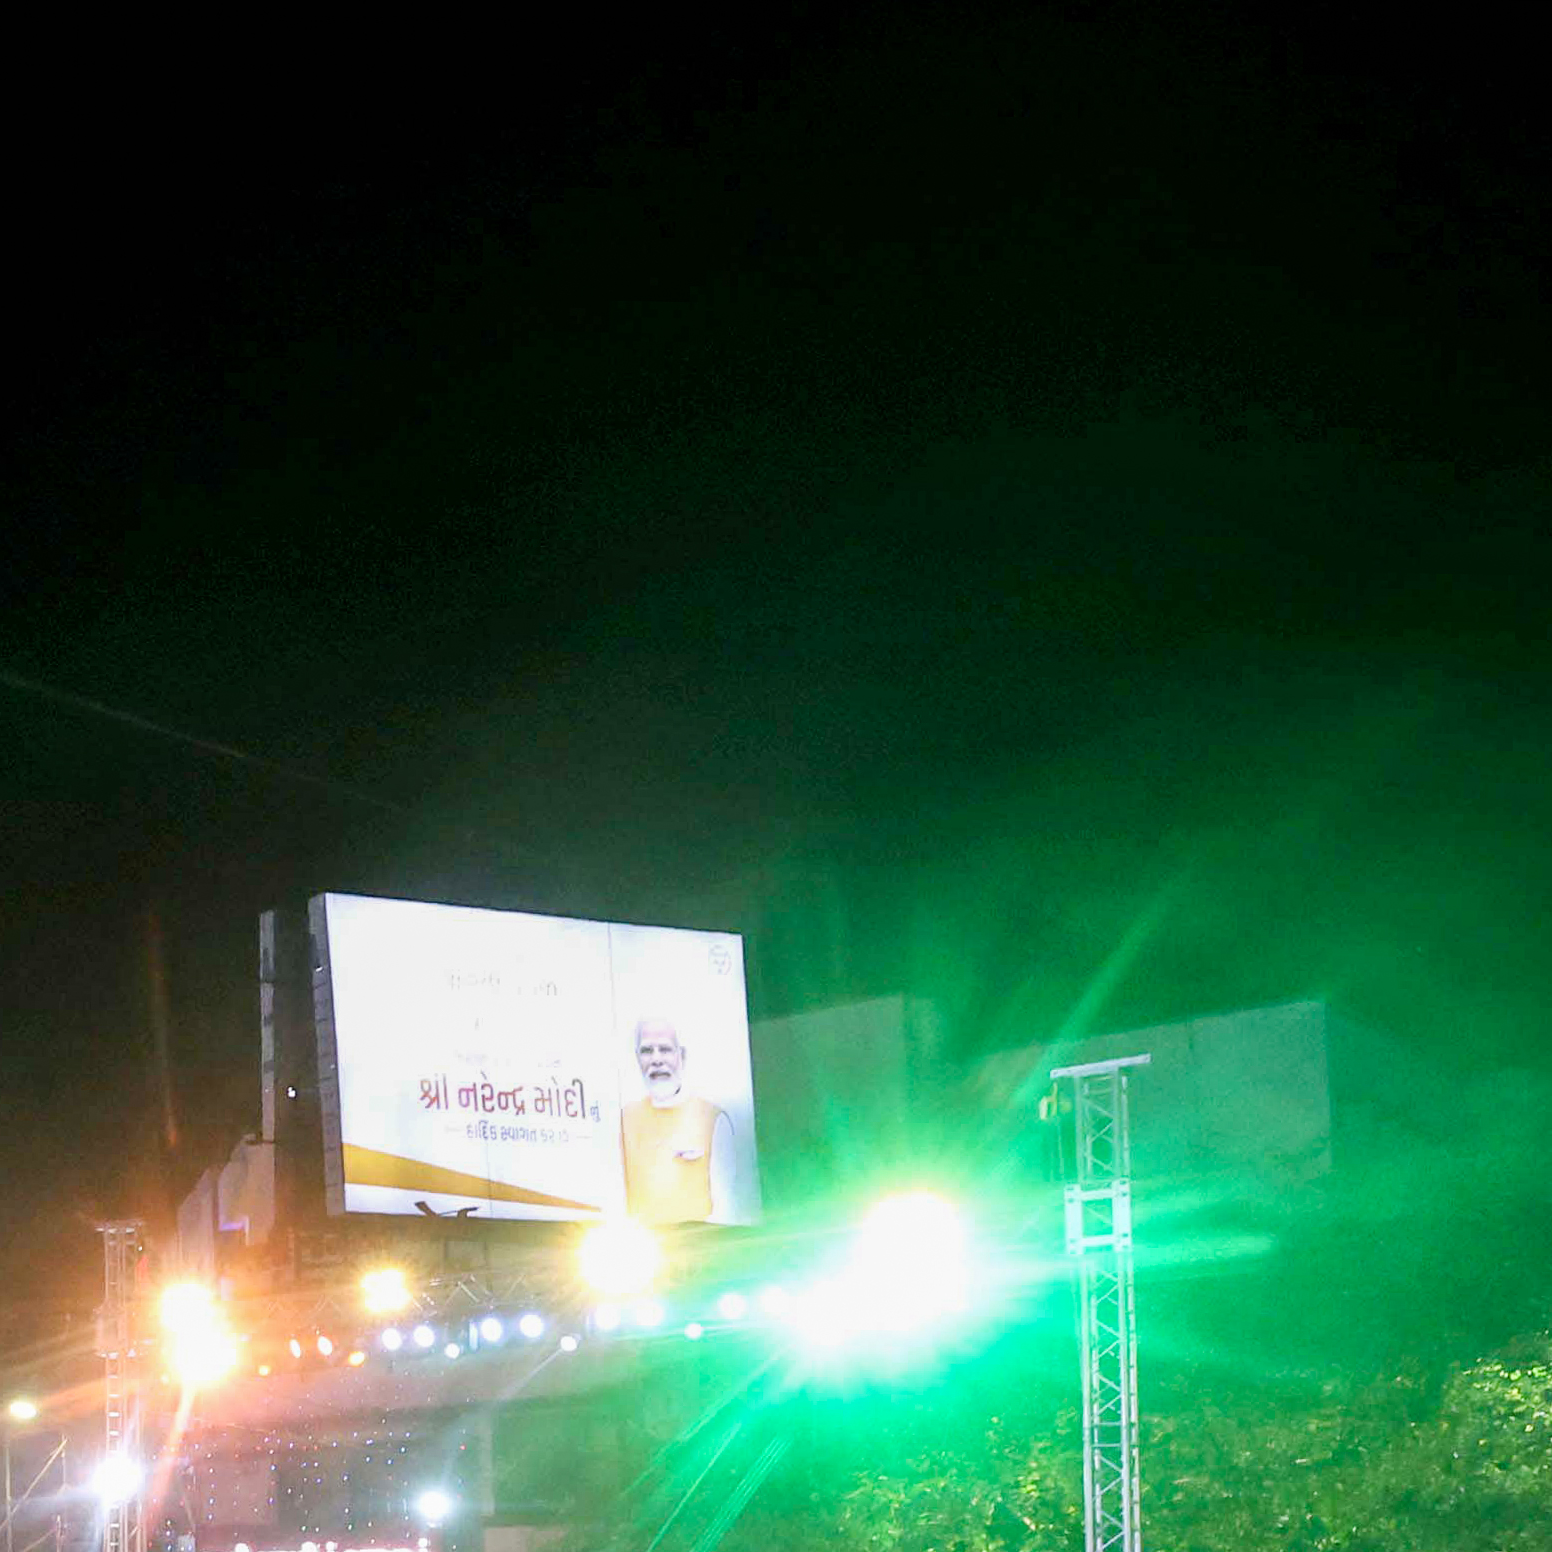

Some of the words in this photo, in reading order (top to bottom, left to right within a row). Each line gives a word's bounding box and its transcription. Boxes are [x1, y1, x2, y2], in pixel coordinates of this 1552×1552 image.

[419, 1072, 450, 1110] શ્રી
[458, 1070, 525, 1116] નરેન્દ્ર
[534, 1076, 587, 1120] મોદી
